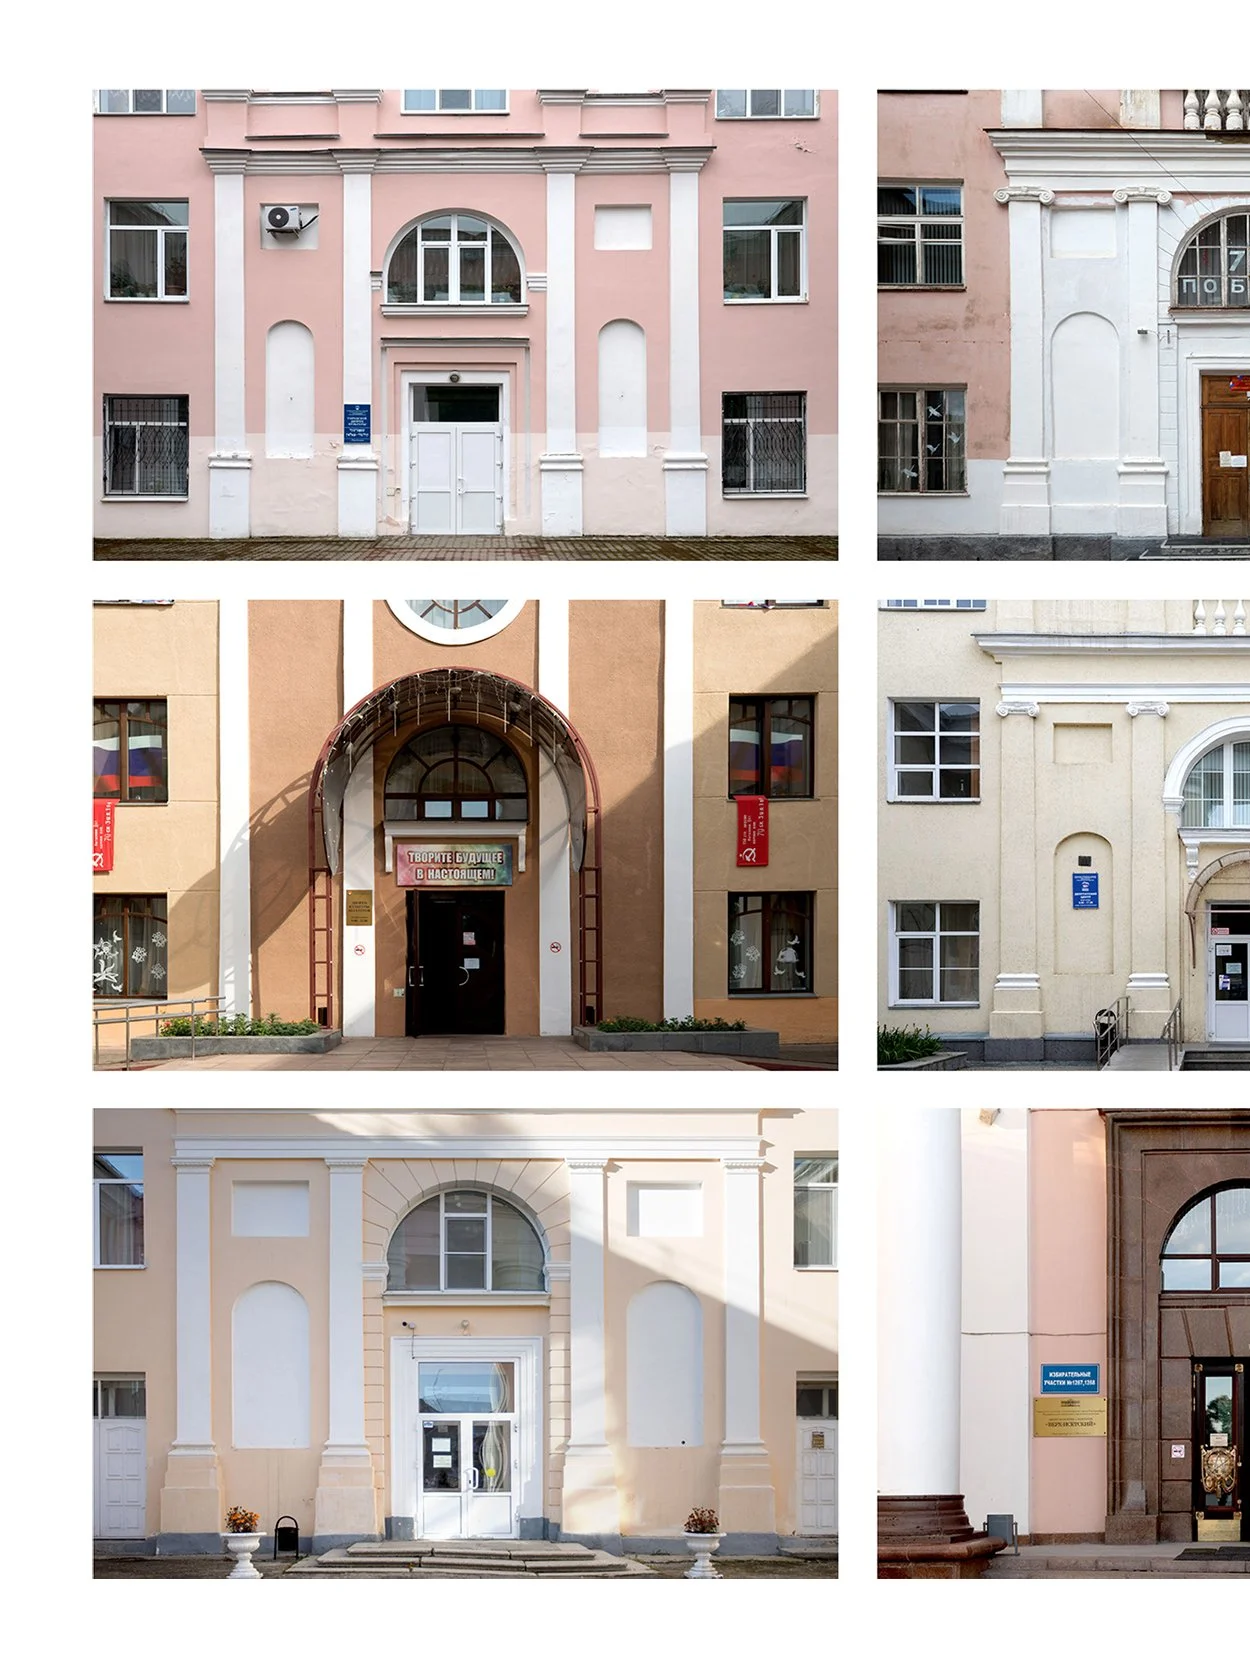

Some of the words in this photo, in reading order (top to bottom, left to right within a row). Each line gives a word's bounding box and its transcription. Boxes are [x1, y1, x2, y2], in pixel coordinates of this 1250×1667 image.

[408, 851, 453, 864] ТВОРИТЕ
[455, 851, 504, 866] БУДУЩЕЕ
[416, 868, 424, 880] В
[427, 868, 495, 882] НАСТОЯЩЕМ!
